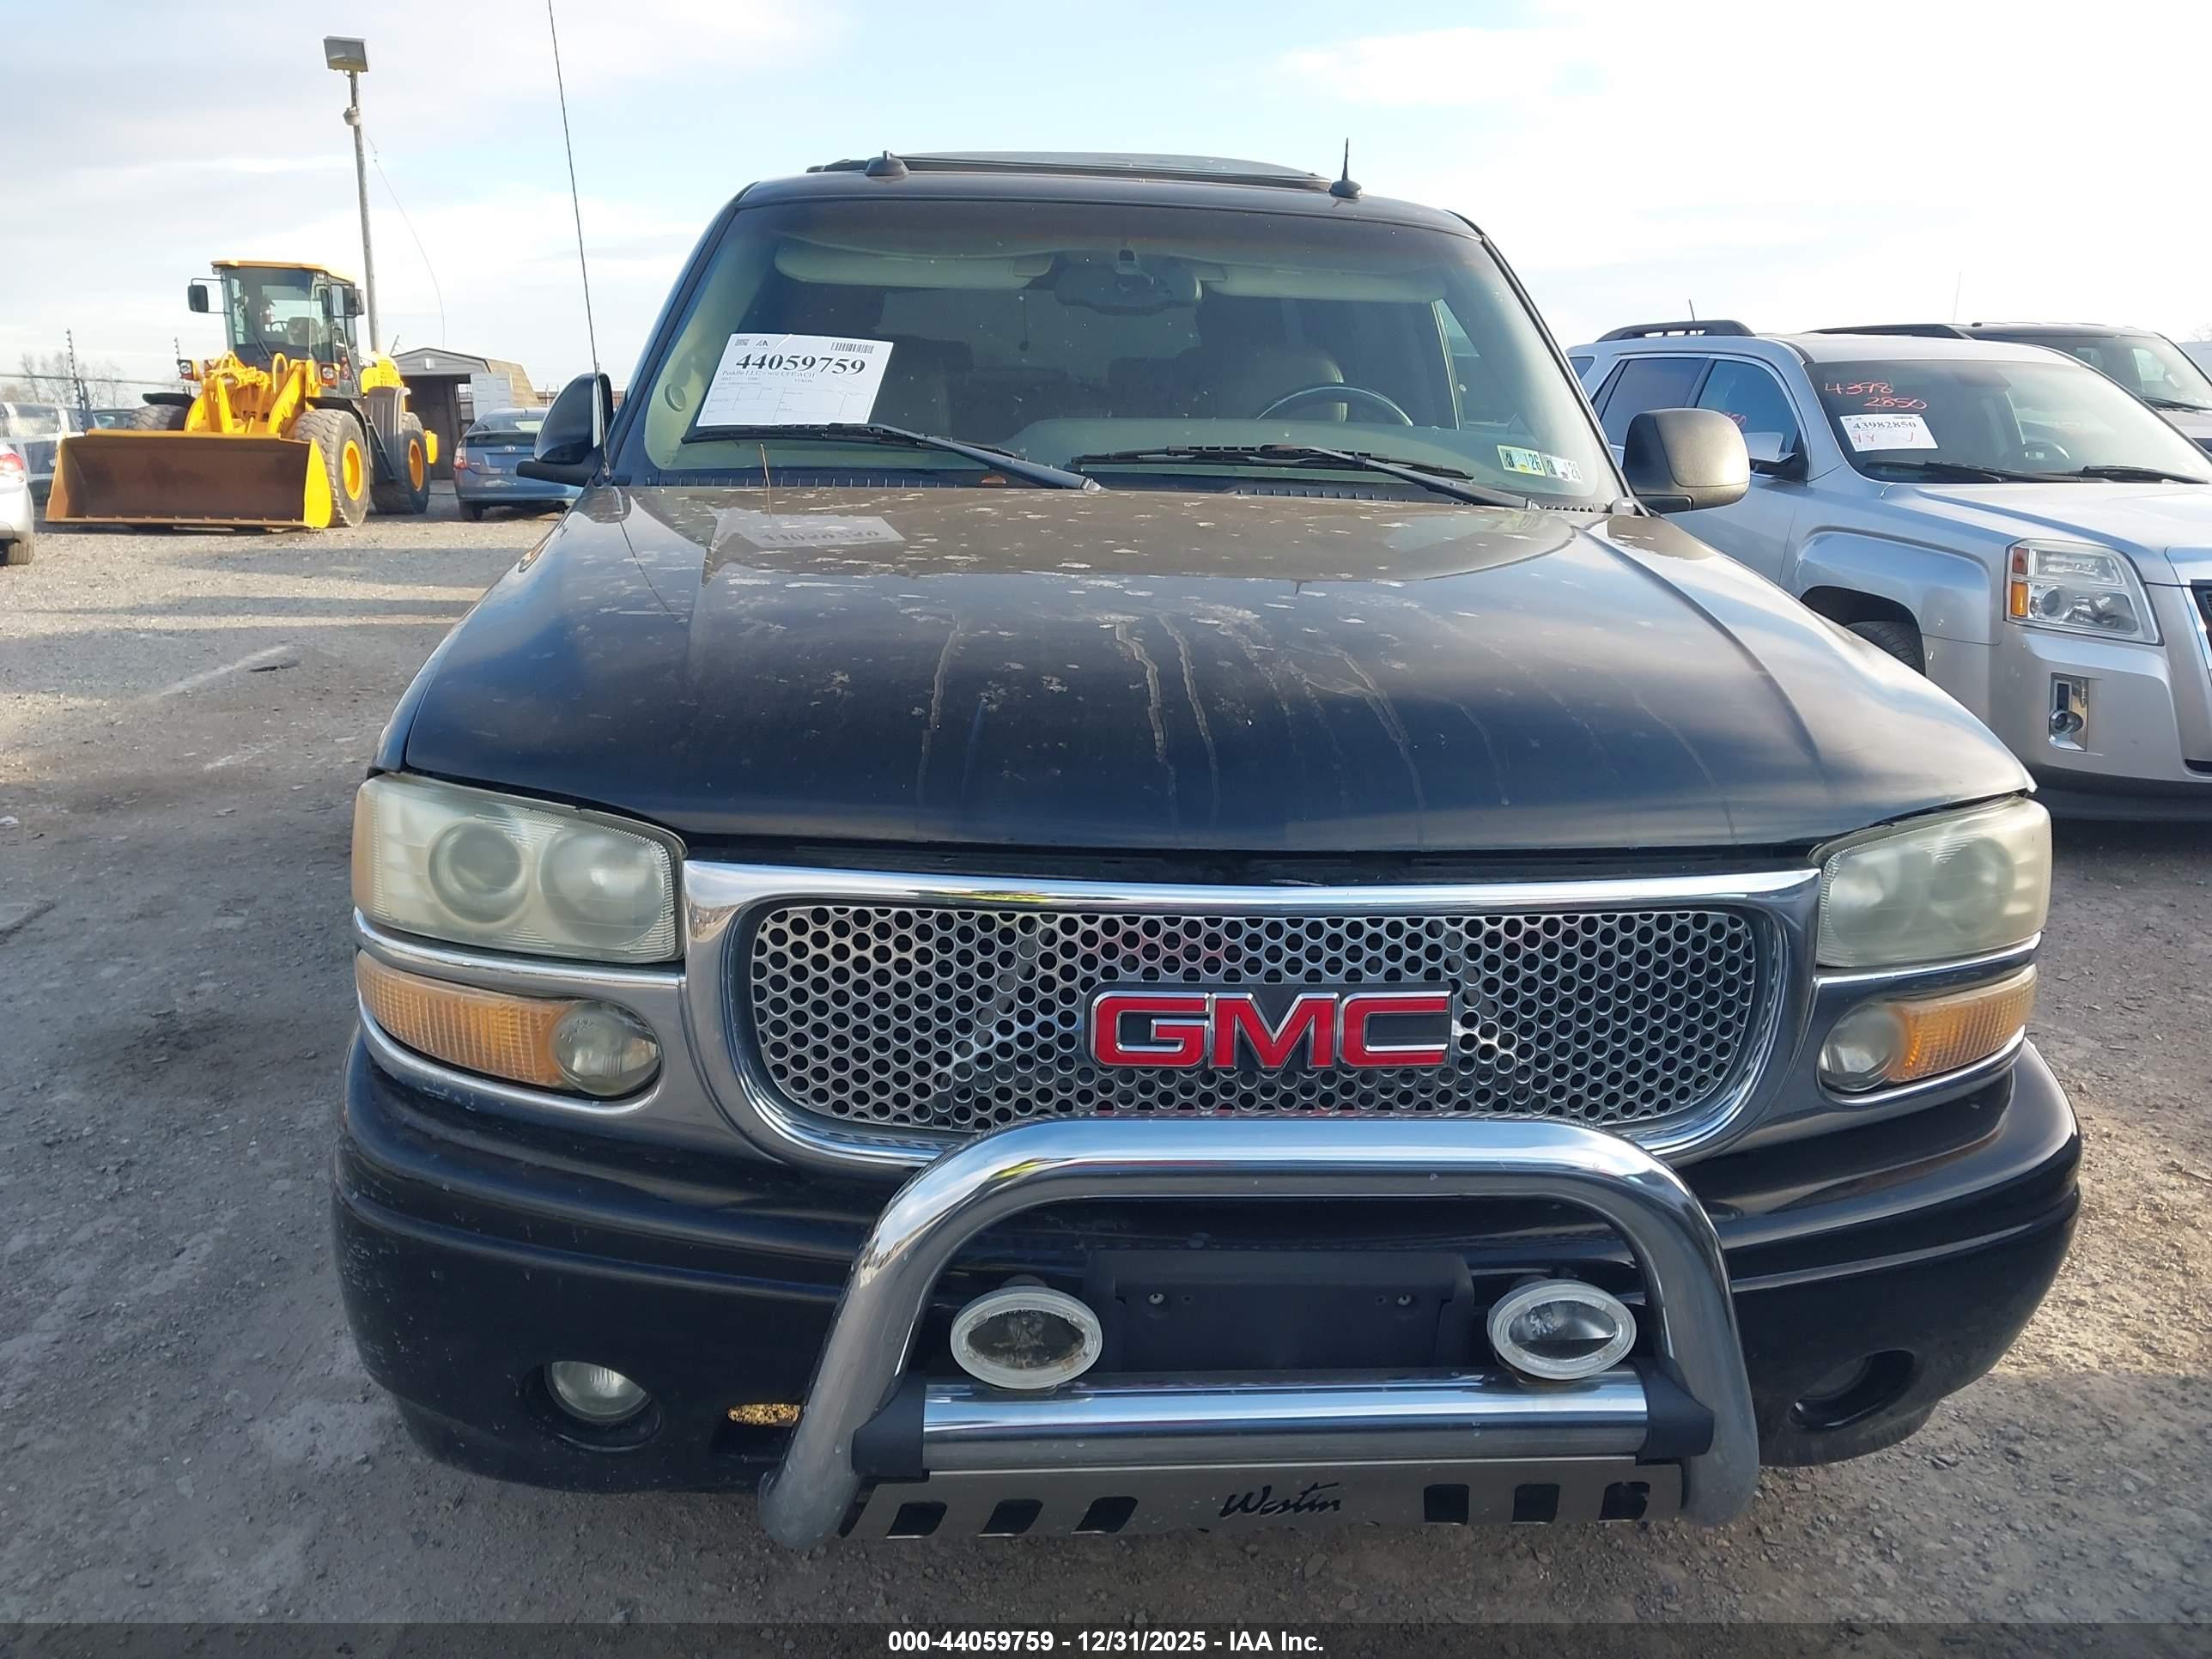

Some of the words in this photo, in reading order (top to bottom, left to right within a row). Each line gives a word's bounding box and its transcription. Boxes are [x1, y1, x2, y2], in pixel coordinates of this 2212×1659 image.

[735, 353, 866, 376] 44059759
[1863, 397, 1928, 410] 2850
[1852, 421, 1917, 429] 43982850
[1505, 453, 1515, 468] 3
[1090, 990, 1451, 1070] GMC
[1218, 1482, 1341, 1517] Westin
